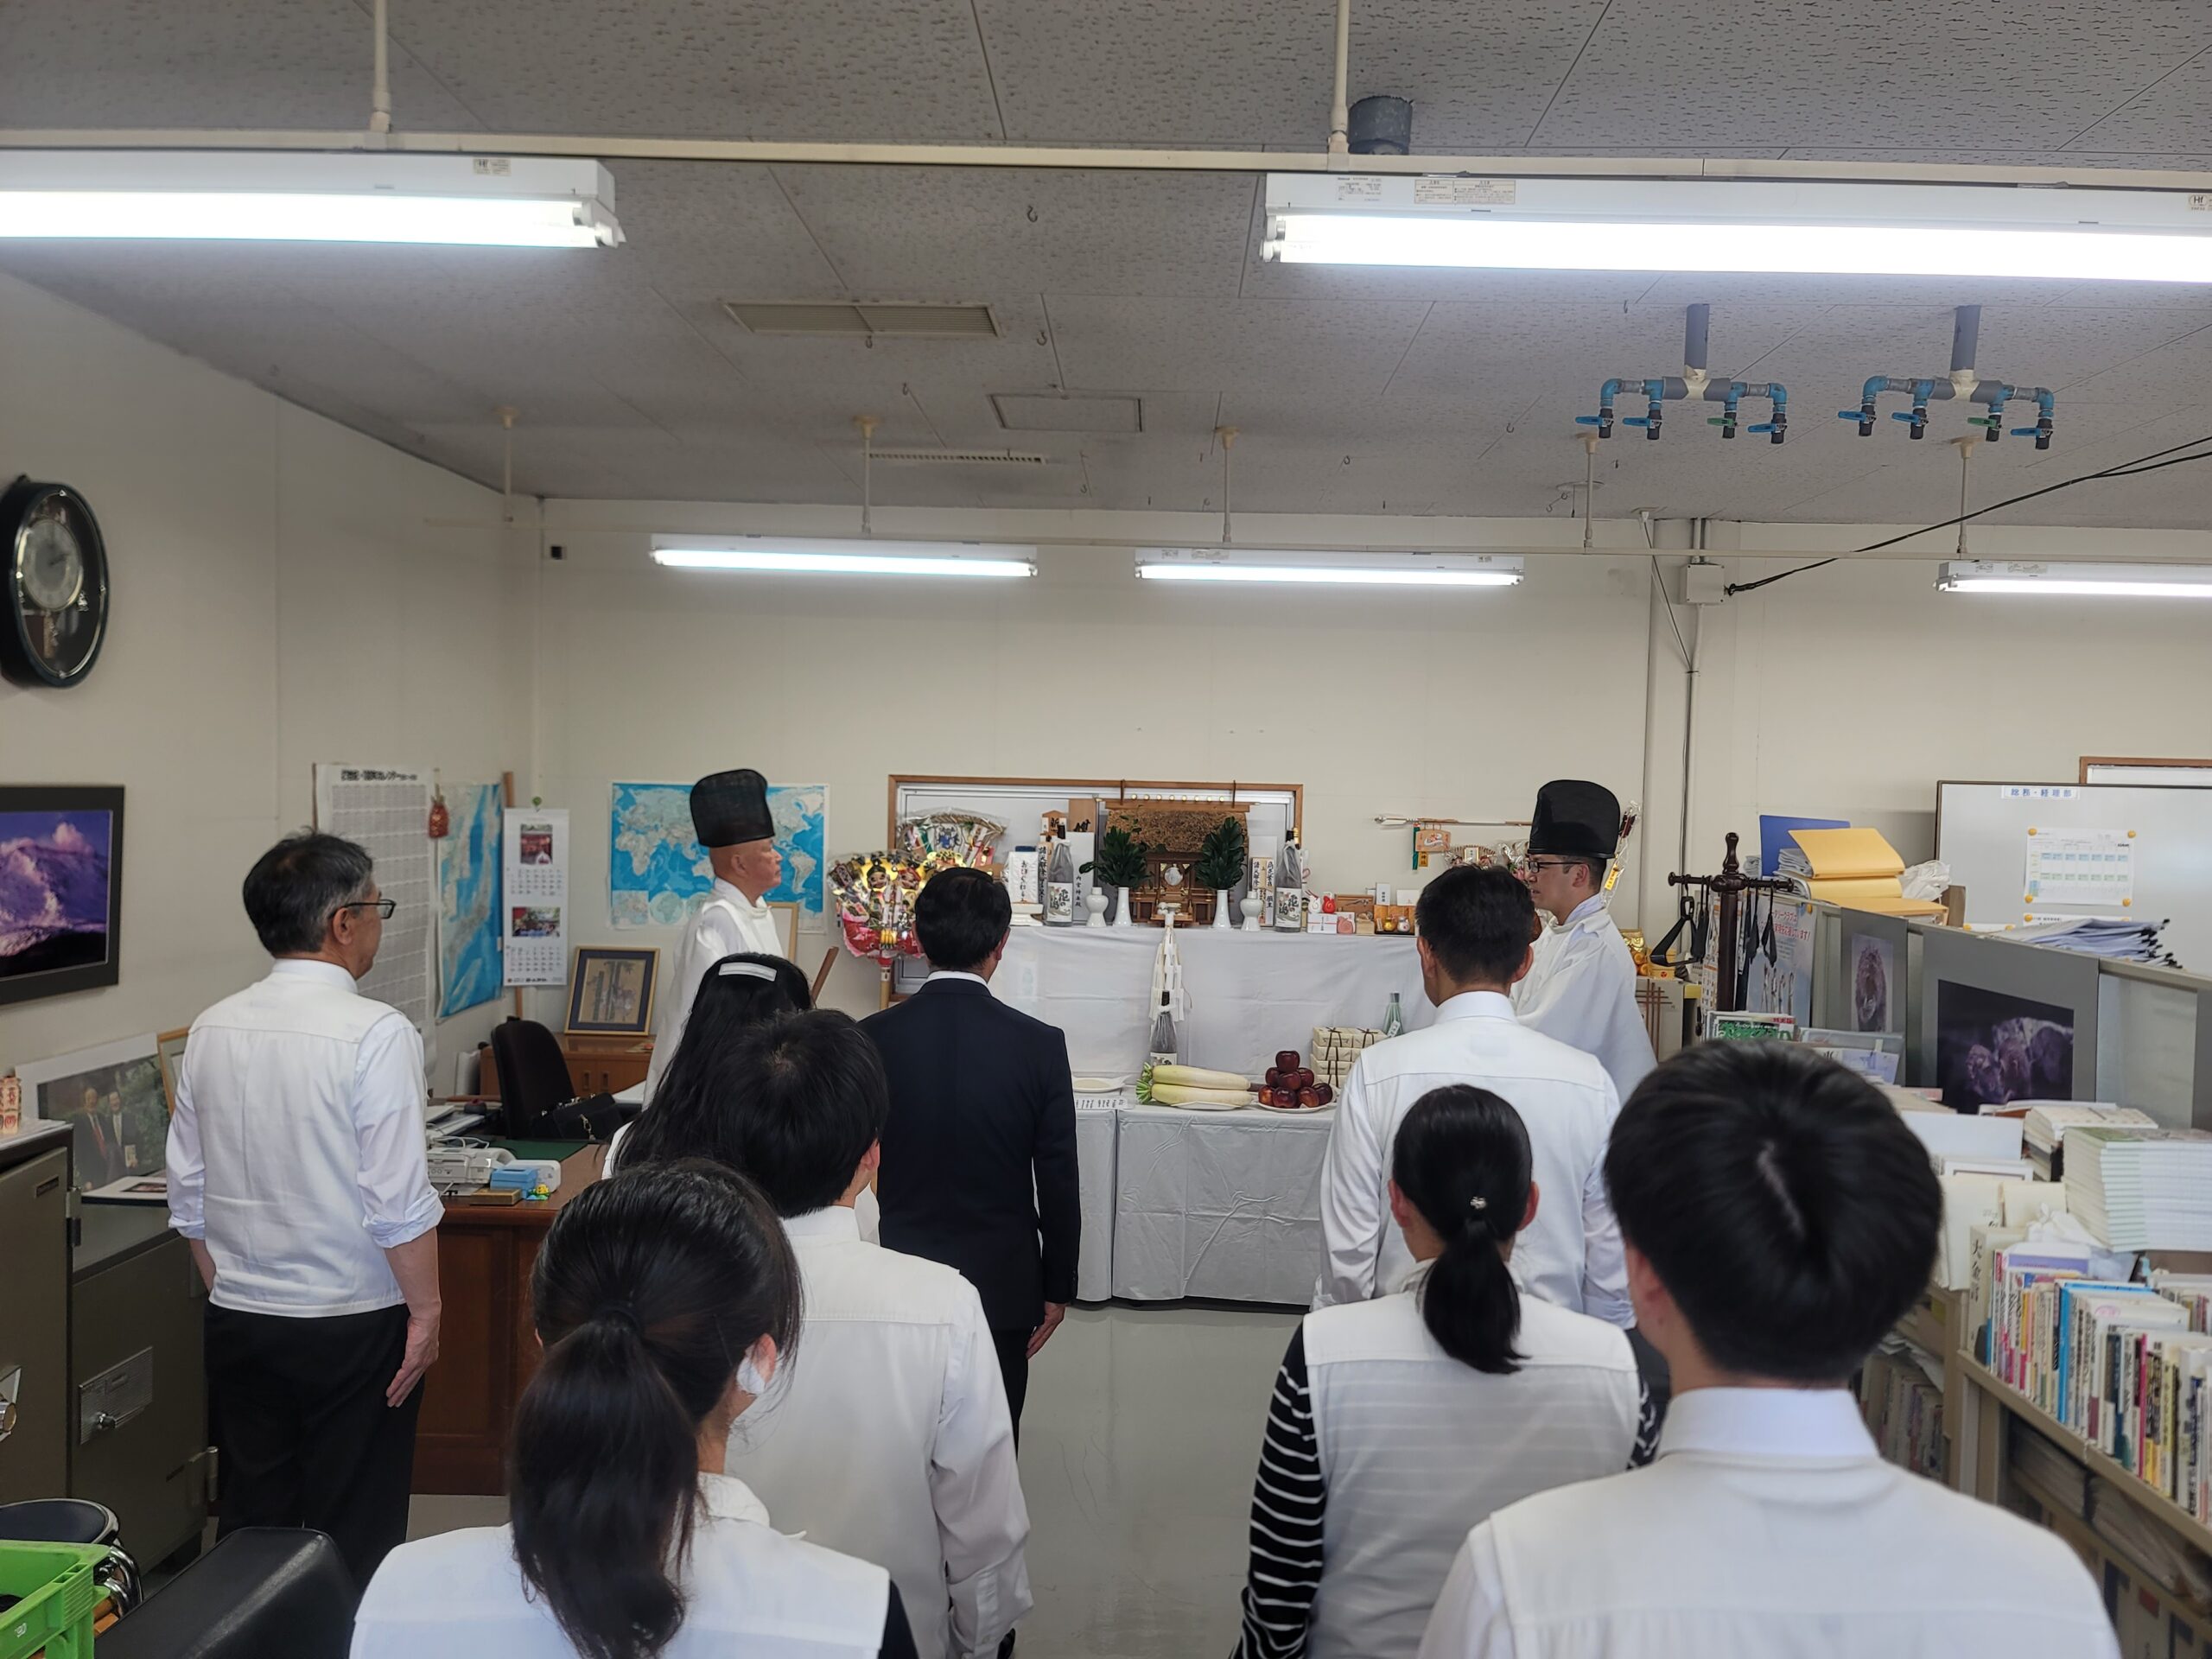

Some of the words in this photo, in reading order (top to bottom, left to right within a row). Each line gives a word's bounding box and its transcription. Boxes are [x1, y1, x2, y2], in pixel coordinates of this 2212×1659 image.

[2011, 787, 2072, 798] 総務・経理部
